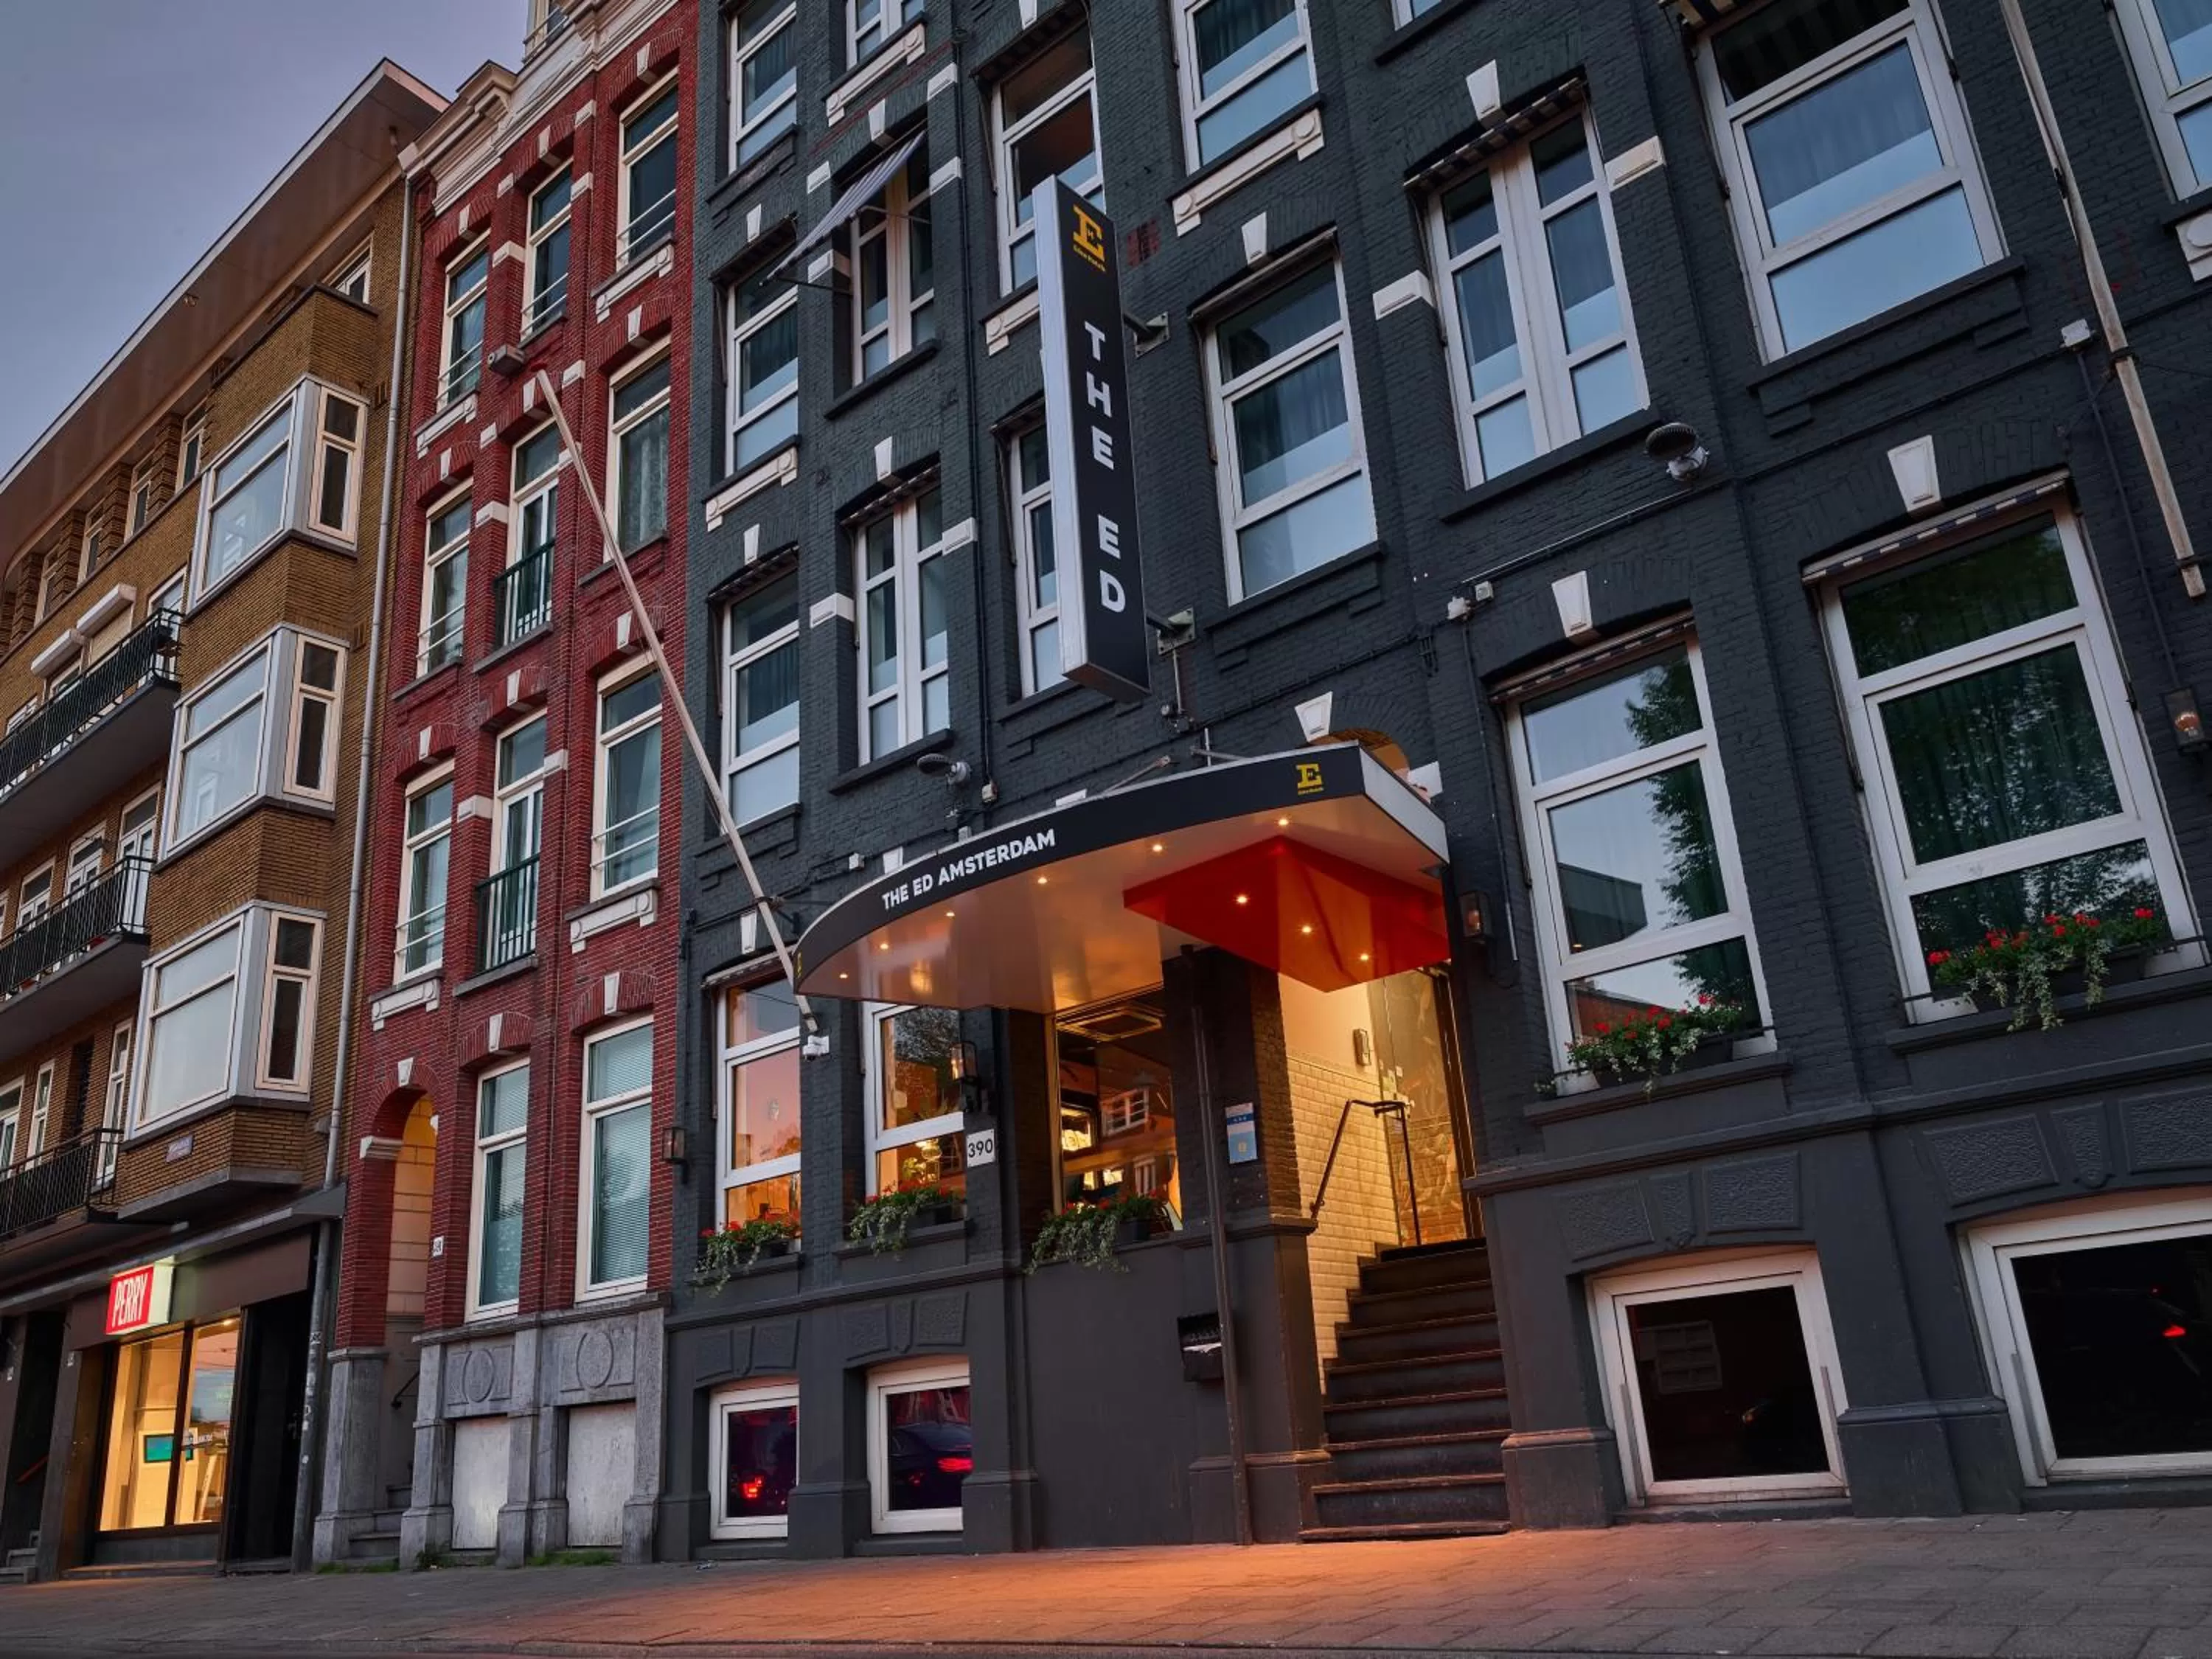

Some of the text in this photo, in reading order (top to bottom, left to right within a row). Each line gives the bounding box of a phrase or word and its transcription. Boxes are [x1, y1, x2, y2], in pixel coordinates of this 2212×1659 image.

[1073, 204, 1105, 262] E
[1084, 321, 1127, 614] THE ED
[1295, 763, 1322, 789] E
[882, 829, 1056, 910] THE ED AMSTERDAM
[968, 1138, 993, 1158] 390
[111, 1273, 148, 1328] PERRY
